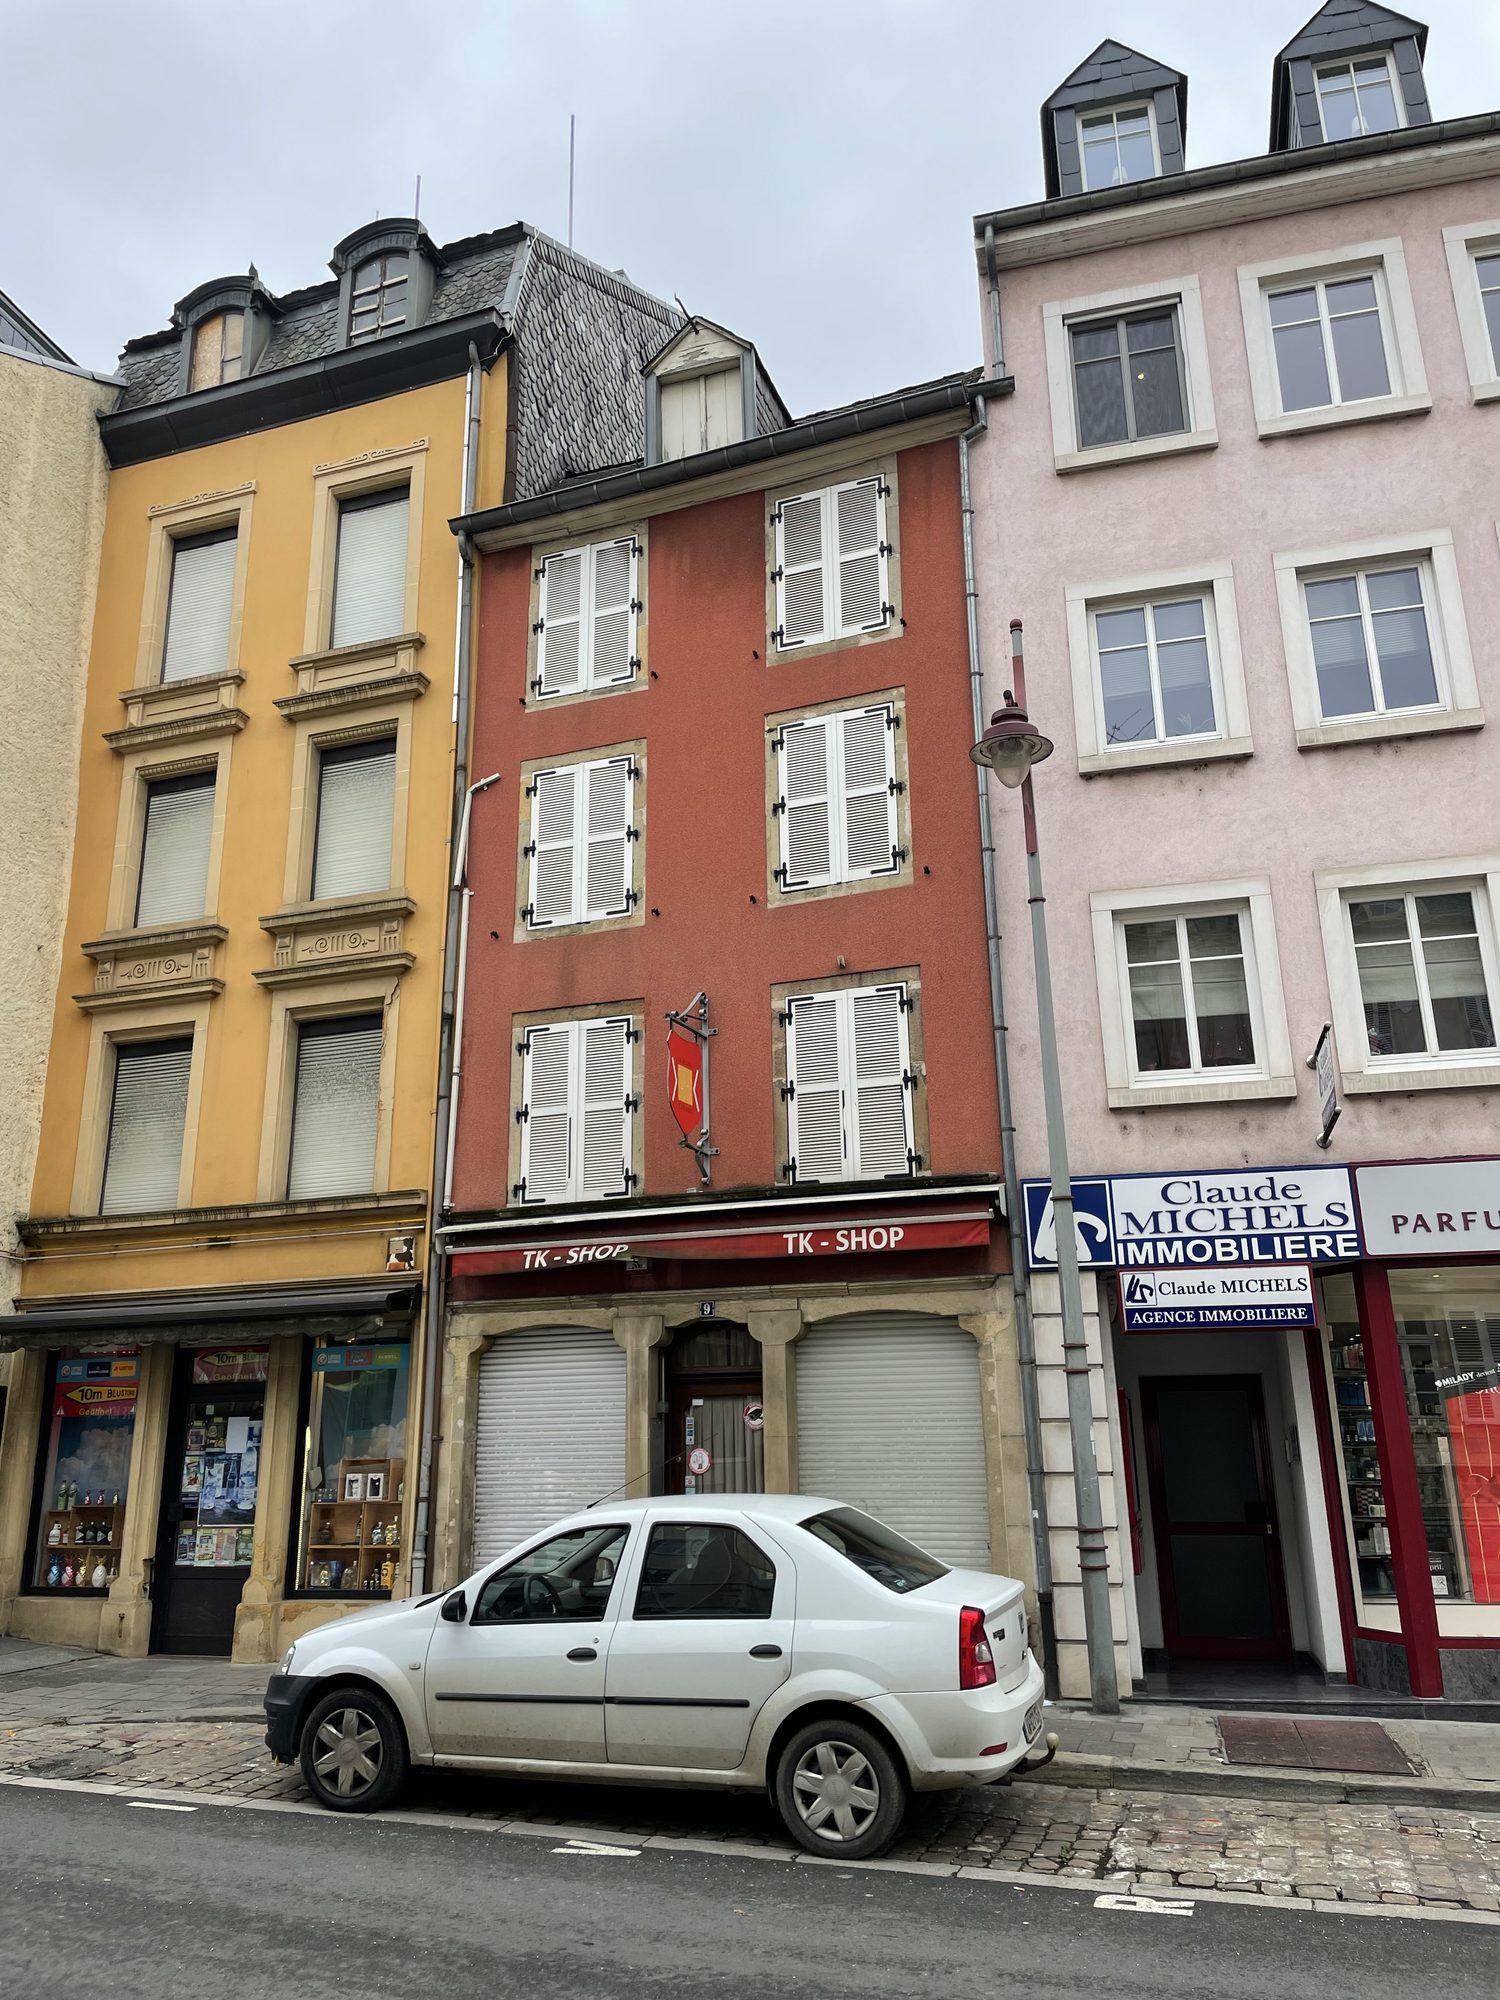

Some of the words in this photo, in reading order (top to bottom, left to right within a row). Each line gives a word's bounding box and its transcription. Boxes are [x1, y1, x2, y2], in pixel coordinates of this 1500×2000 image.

[1161, 1177, 1303, 1205] Claude
[1120, 1202, 1350, 1236] MICHELS
[783, 1231, 815, 1255] TK
[835, 1226, 905, 1252] SHOP
[1117, 1232, 1360, 1266] IMMOBILIERE
[523, 1248, 549, 1270] TK
[565, 1243, 629, 1265] SHOP
[1158, 1280, 1216, 1296] Claude
[1220, 1277, 1308, 1294] MICHELS
[703, 1303, 711, 1315] 9
[1132, 1311, 1196, 1325] AGENCE
[1199, 1307, 1308, 1323] IMMOBILIERE
[1441, 1371, 1474, 1387] MILADY
[78, 1387, 102, 1401] 10m
